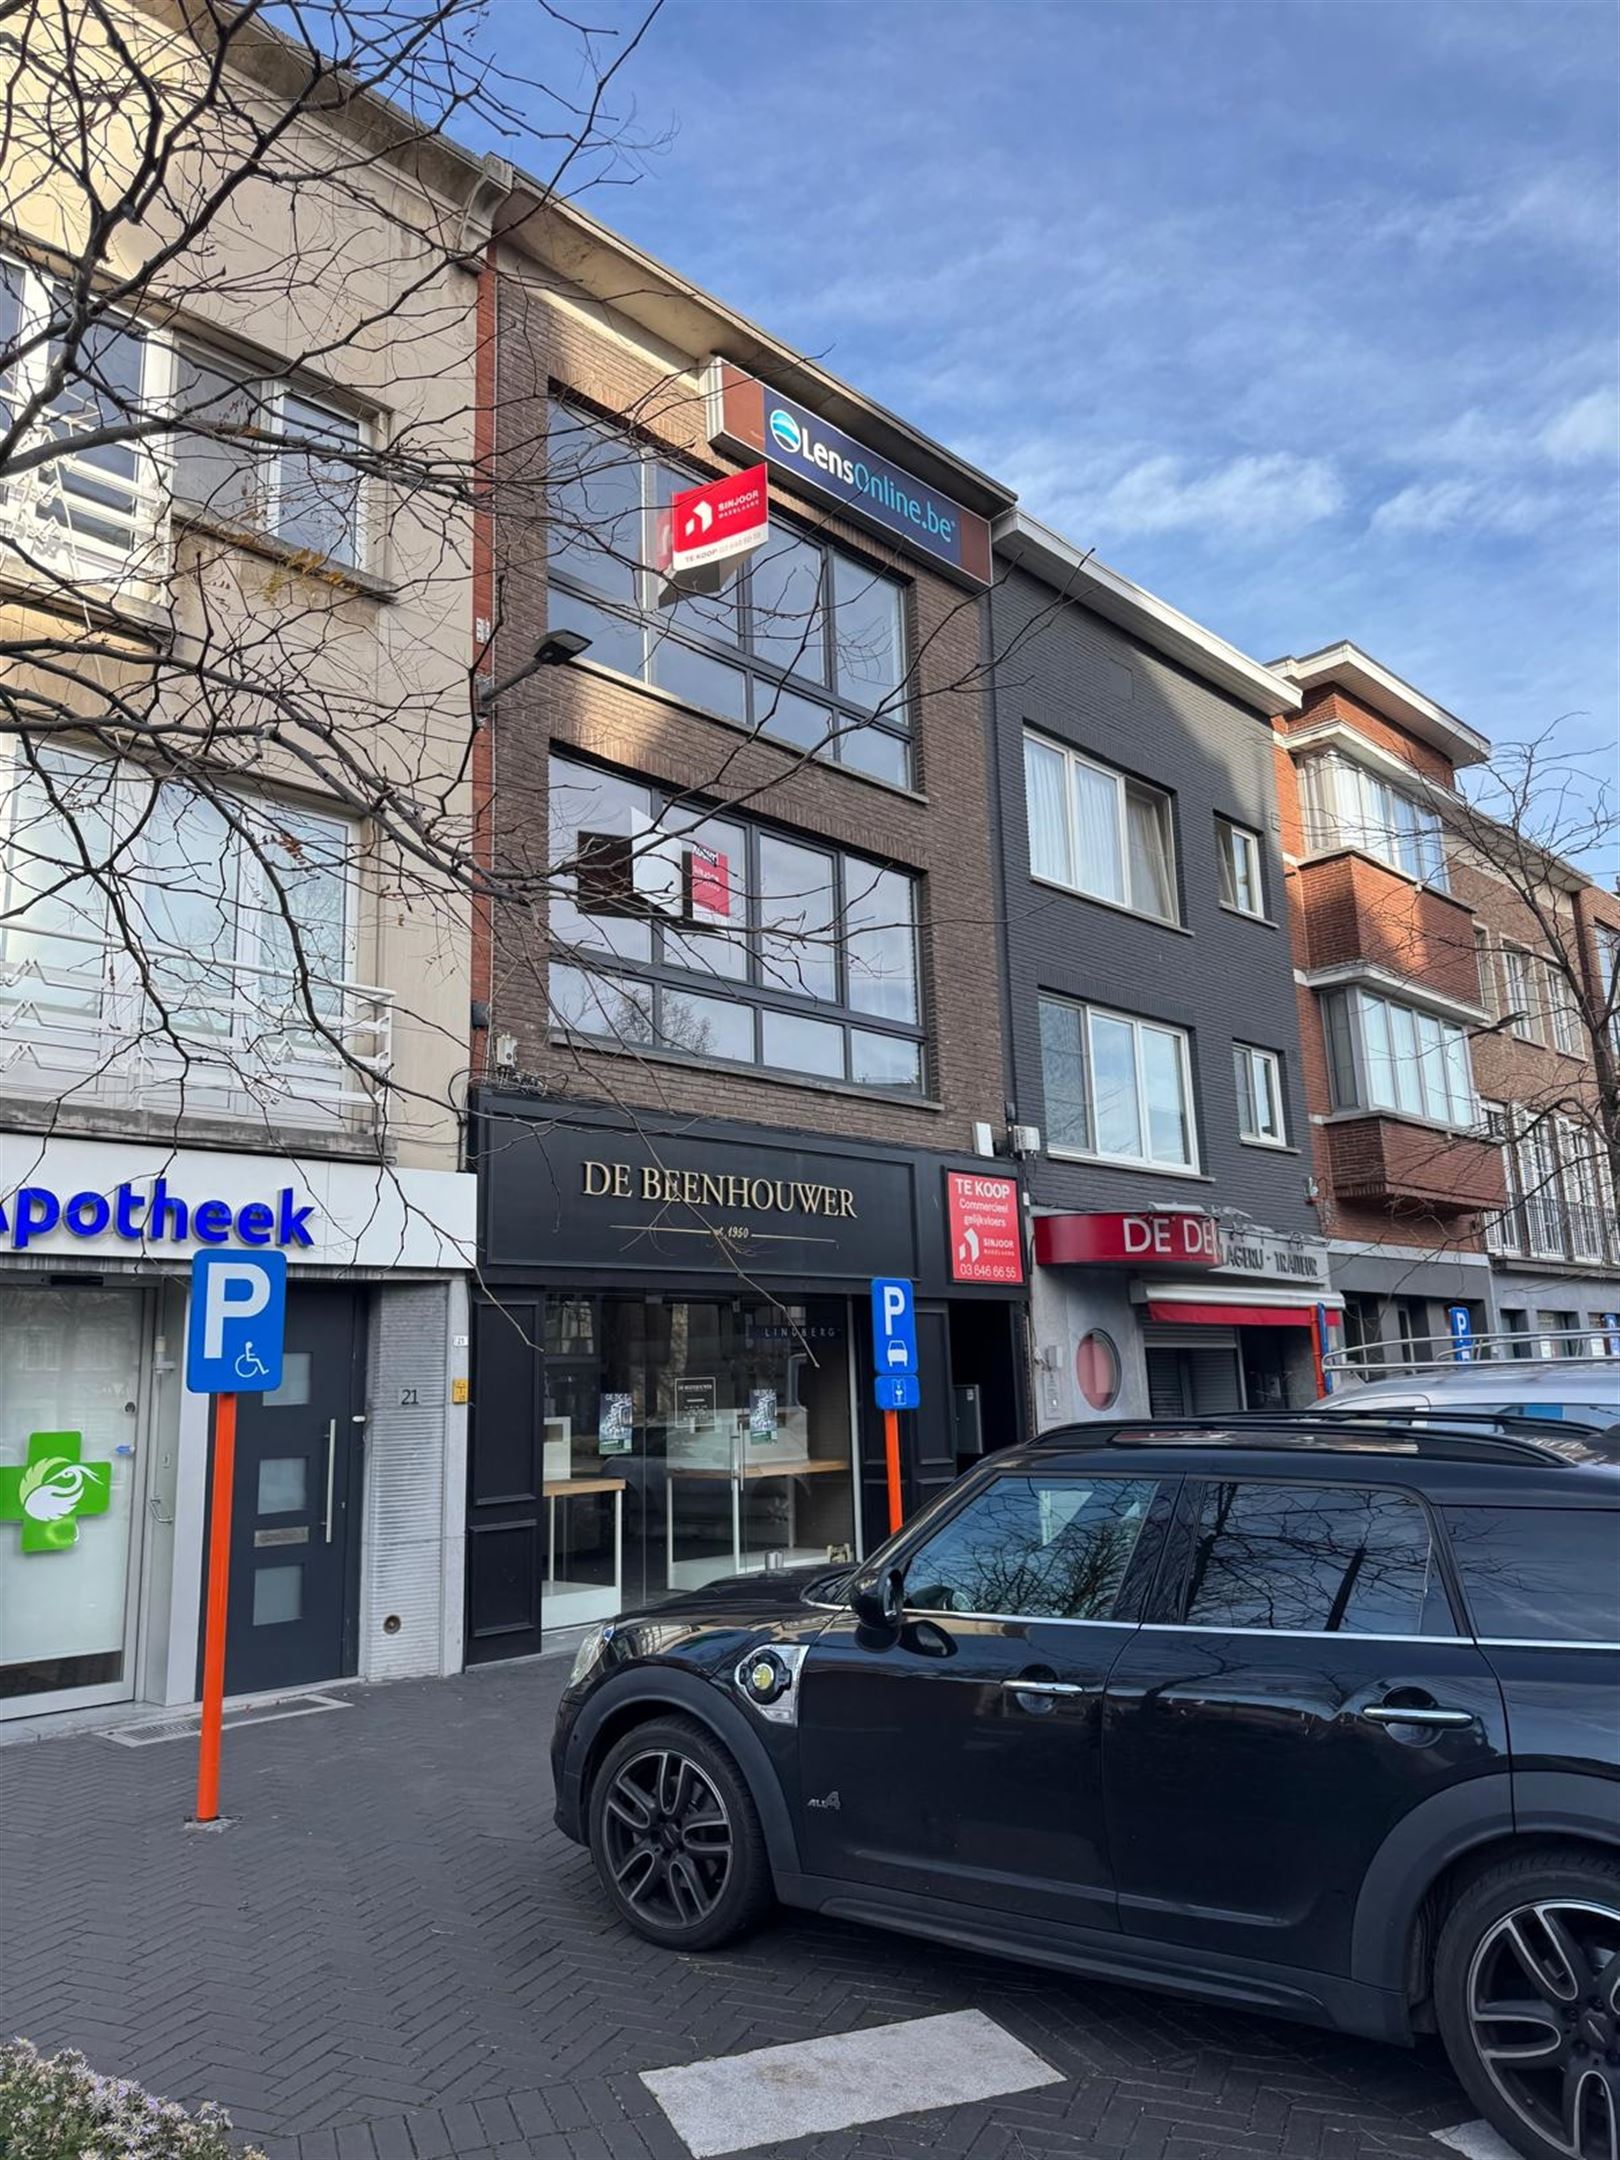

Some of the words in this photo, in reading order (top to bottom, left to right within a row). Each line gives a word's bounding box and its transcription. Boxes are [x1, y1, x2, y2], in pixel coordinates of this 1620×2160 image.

[802, 428, 952, 543] LensOnline.be
[718, 490, 759, 511] SINJOOR
[583, 1161, 633, 1198] DE
[640, 1167, 858, 1218] BEENHOUWER
[956, 1178, 973, 1196] TE
[975, 1181, 1010, 1199] KOOP
[0, 1176, 316, 1249] potheek
[959, 1198, 1009, 1213] Commercieel
[983, 1237, 1015, 1249] SINJOOR
[1122, 1218, 1172, 1254] DE
[960, 1263, 973, 1276] 03
[204, 1262, 271, 1359] P
[884, 1286, 905, 1336] P
[764, 1327, 835, 1338] LINDBERG
[1456, 1312, 1466, 1343] P
[401, 1388, 420, 1405] 21
